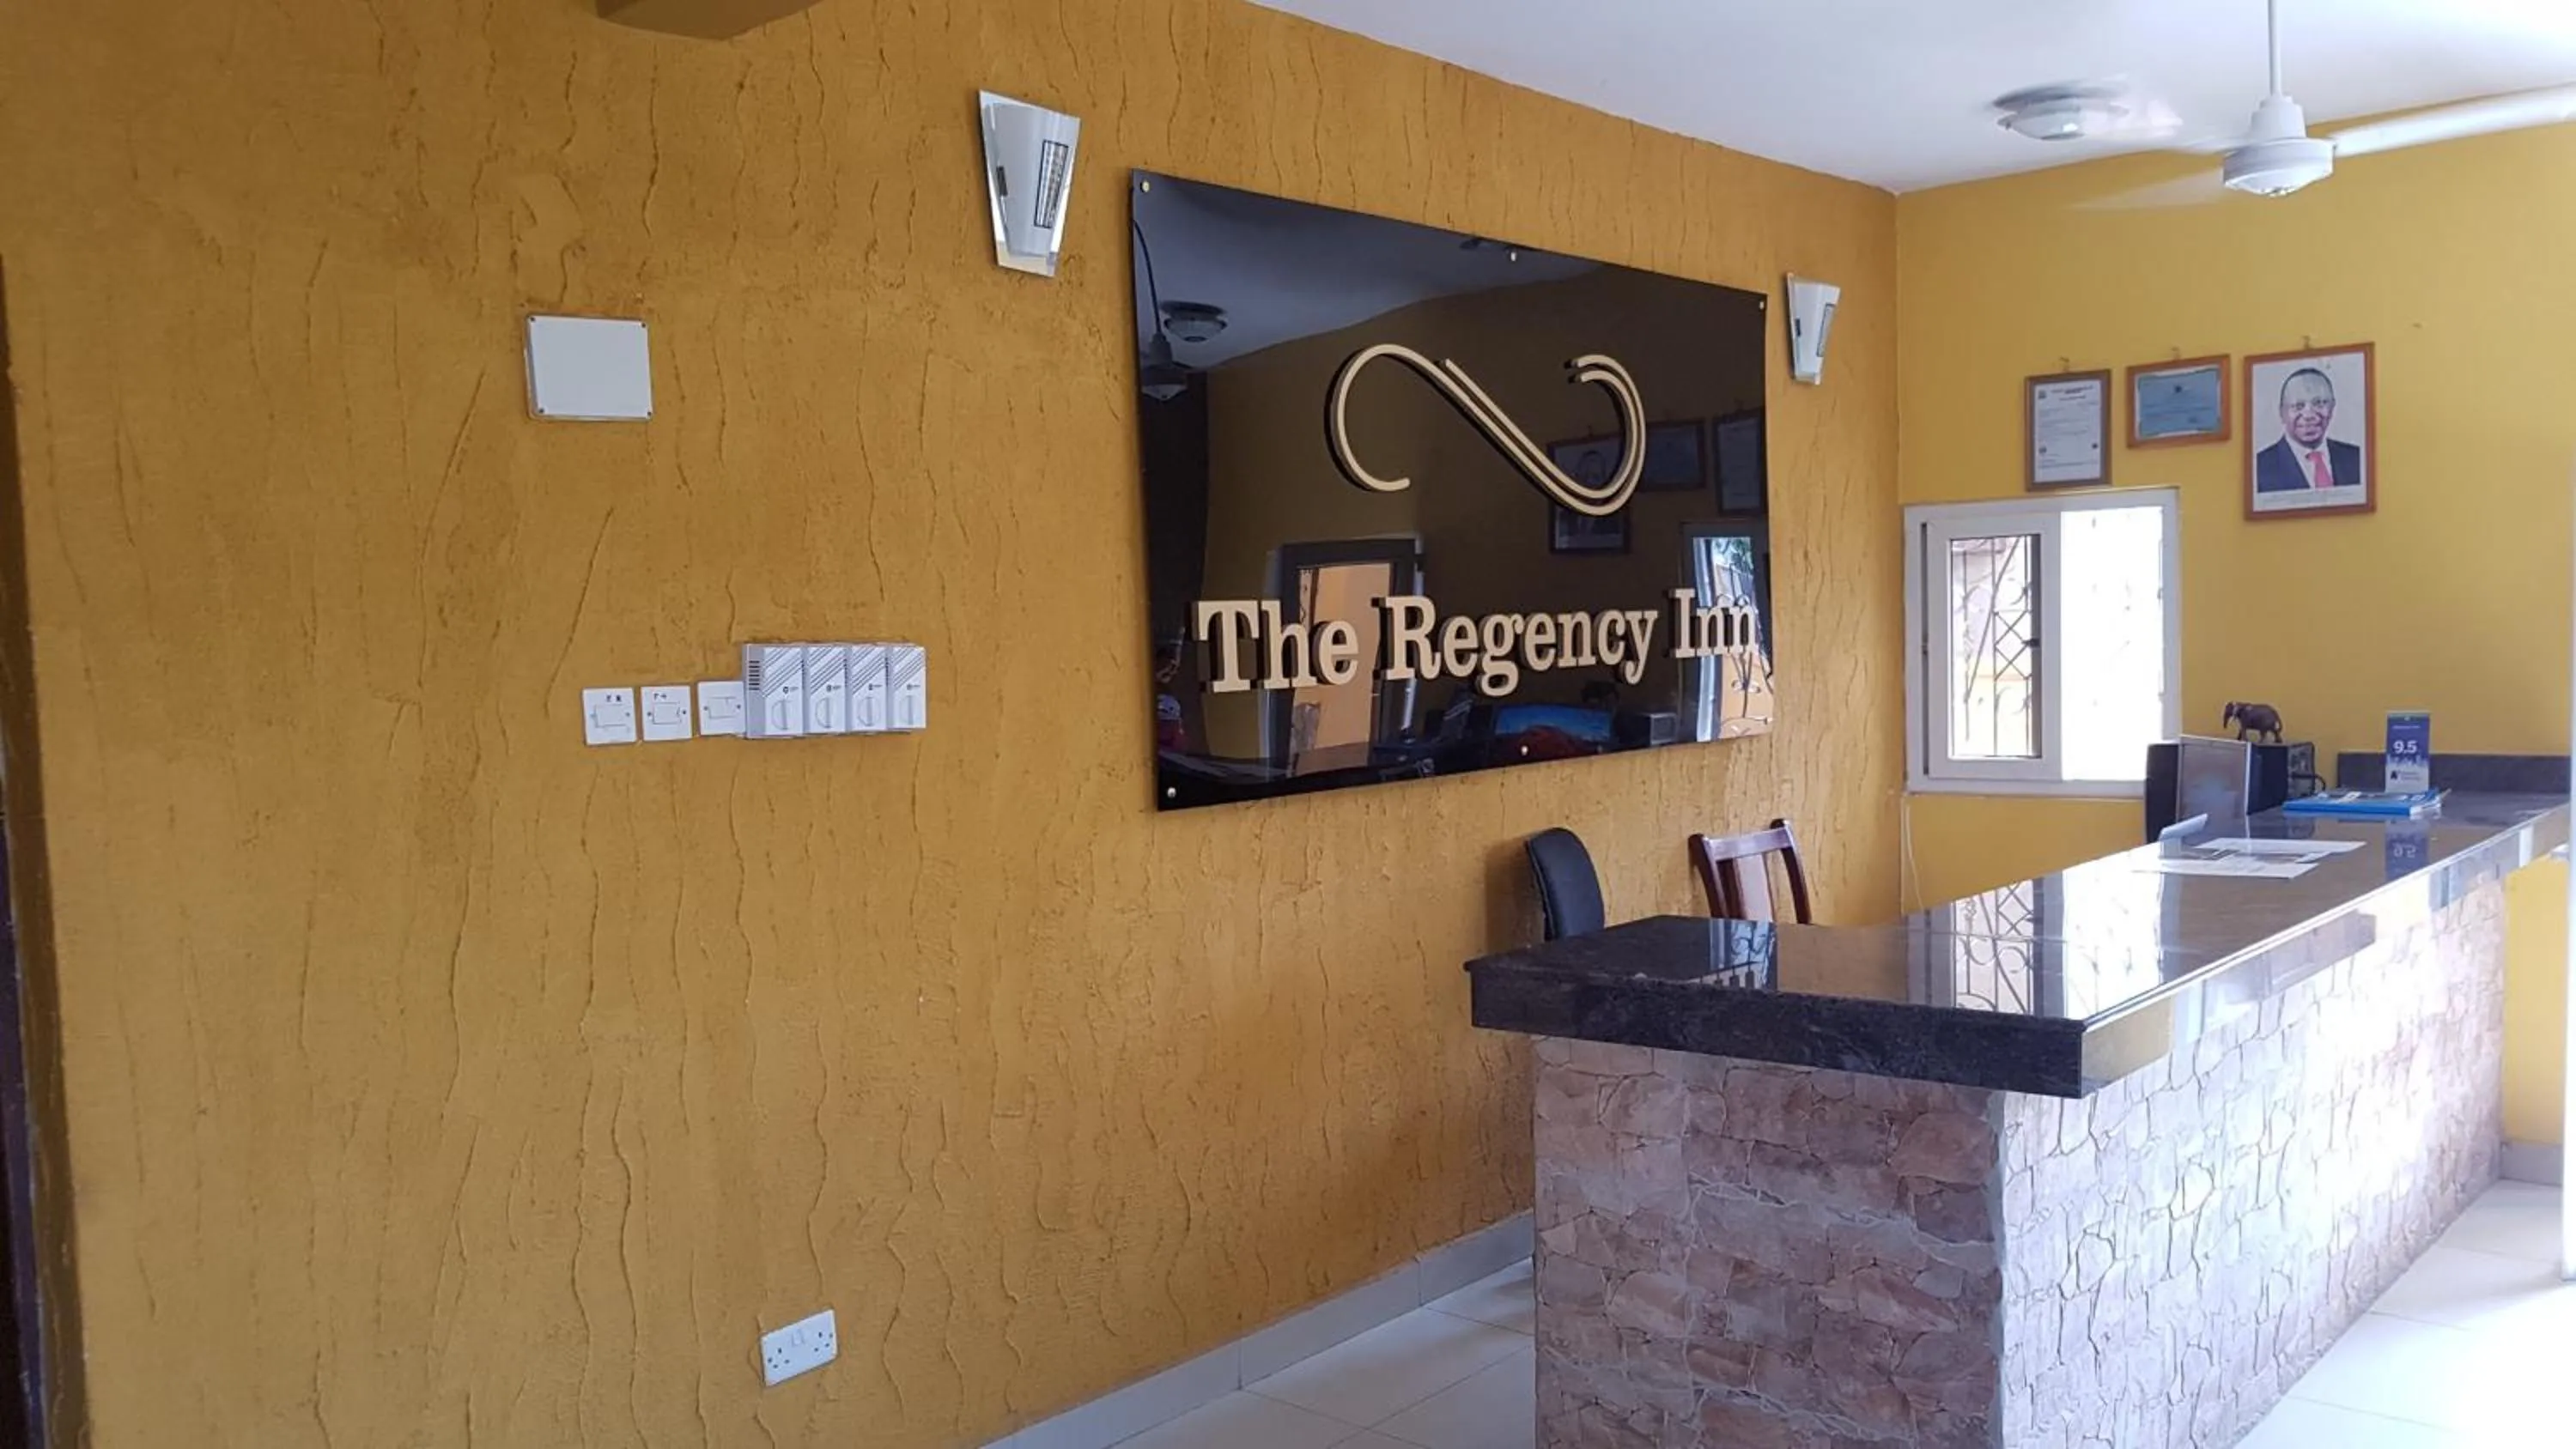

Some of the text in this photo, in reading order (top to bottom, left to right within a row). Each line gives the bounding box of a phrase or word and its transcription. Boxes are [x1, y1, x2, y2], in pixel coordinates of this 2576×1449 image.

[1196, 587, 1758, 696] The Regency Inn
[2392, 739, 2418, 754] 9.5
